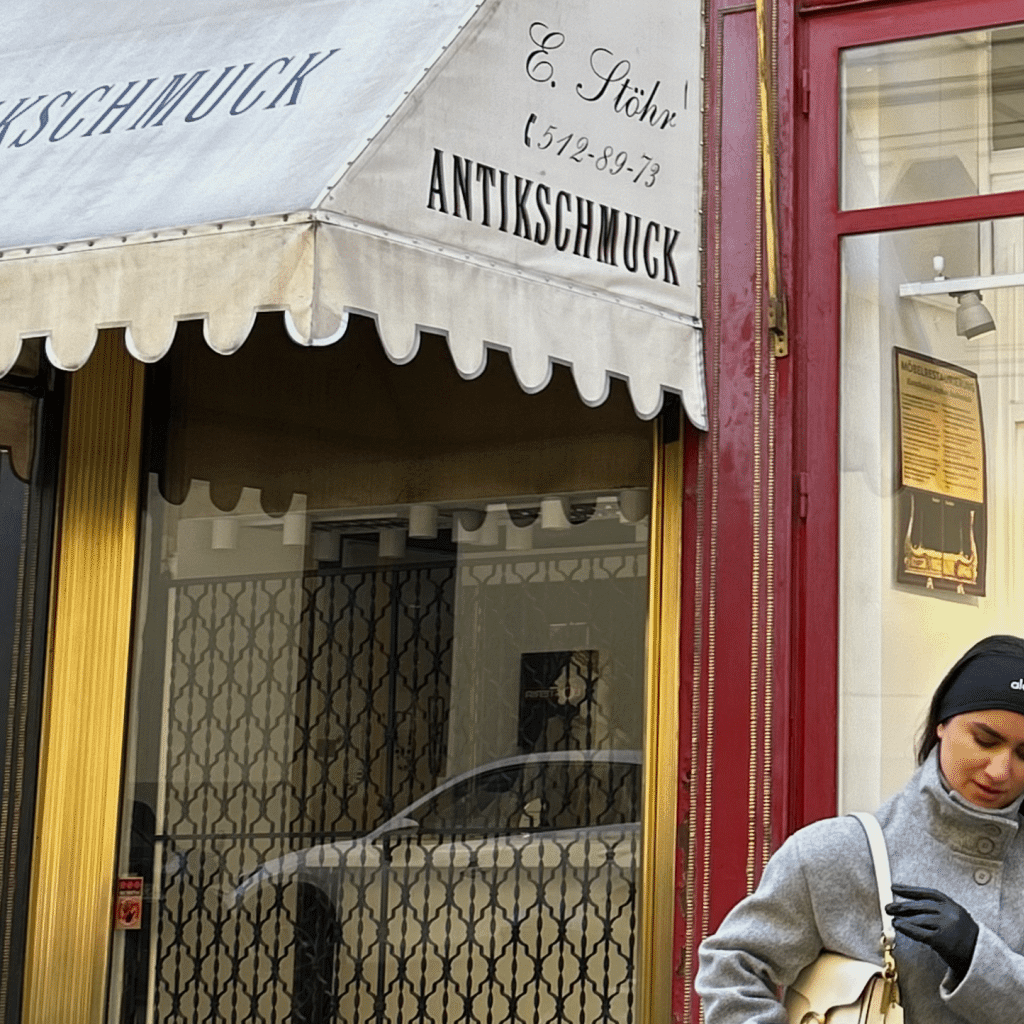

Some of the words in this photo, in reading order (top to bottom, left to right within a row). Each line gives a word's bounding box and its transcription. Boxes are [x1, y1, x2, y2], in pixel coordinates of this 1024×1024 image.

[525, 21, 566, 88] E.
[575, 47, 678, 130] Stöhr
[536, 124, 661, 188] 512-89-73
[426, 147, 681, 287] ANTIKSCHMUCK
